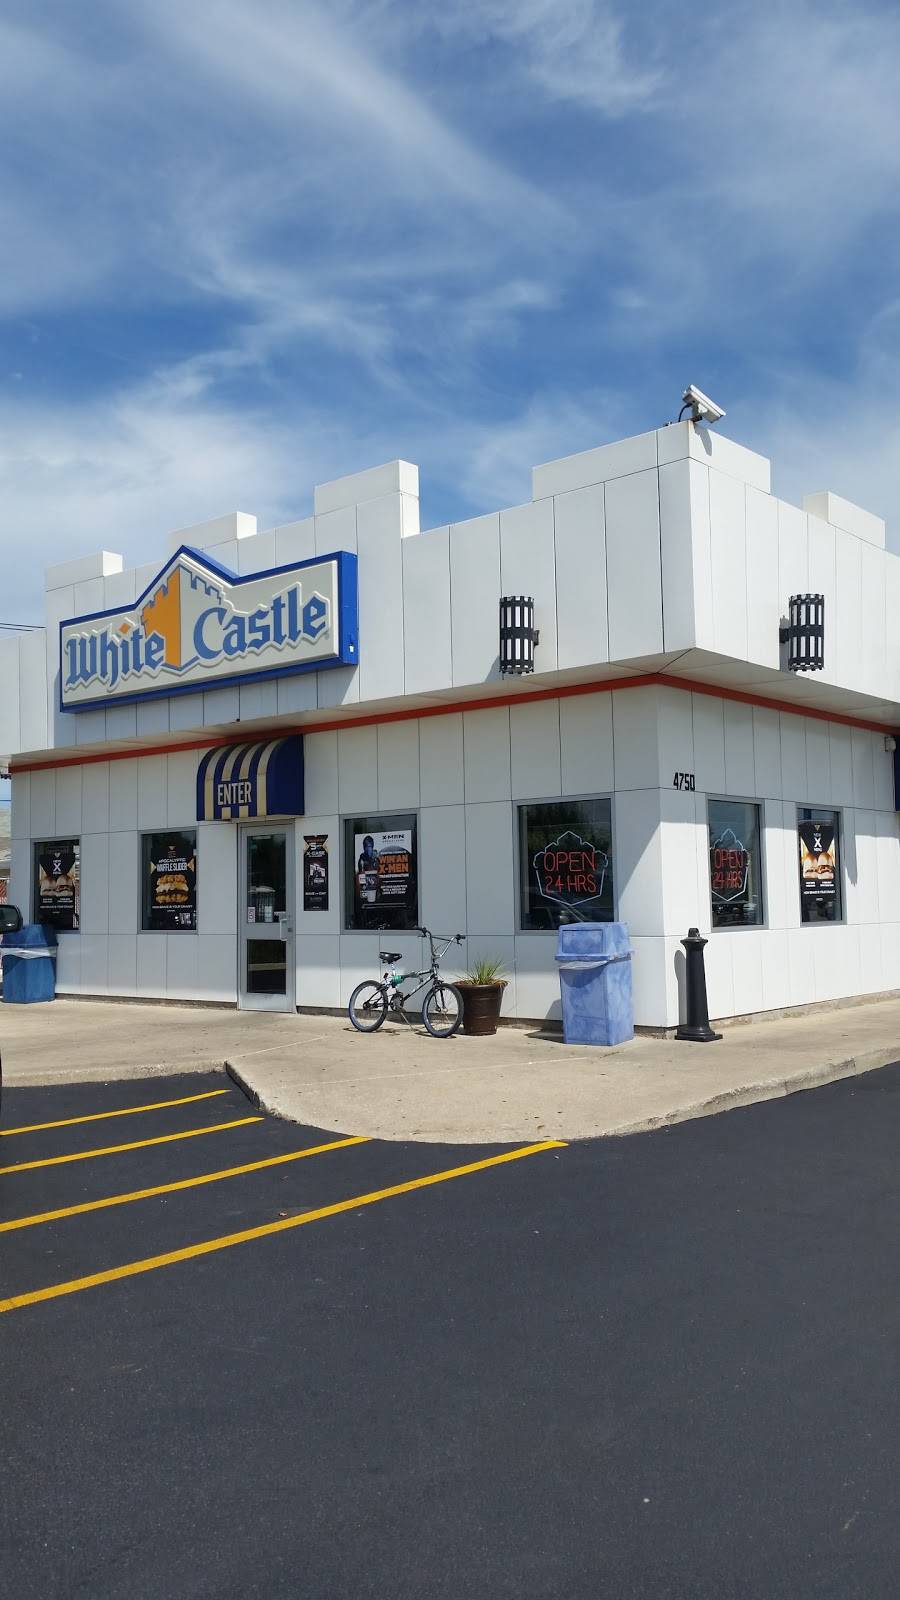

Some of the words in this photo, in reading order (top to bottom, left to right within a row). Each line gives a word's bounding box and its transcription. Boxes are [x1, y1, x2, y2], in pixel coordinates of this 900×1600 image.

[65, 622, 165, 687] White
[193, 587, 327, 660] Castle
[673, 772, 695, 791] 4750
[217, 781, 252, 806] ENTER
[156, 863, 173, 872] WAFFLE
[173, 862, 188, 871] SLIDER
[379, 863, 409, 874] X-MEN
[543, 851, 596, 872] OPEN
[713, 849, 743, 869] OPEN
[545, 875, 563, 894] 24
[566, 873, 597, 893] HRS
